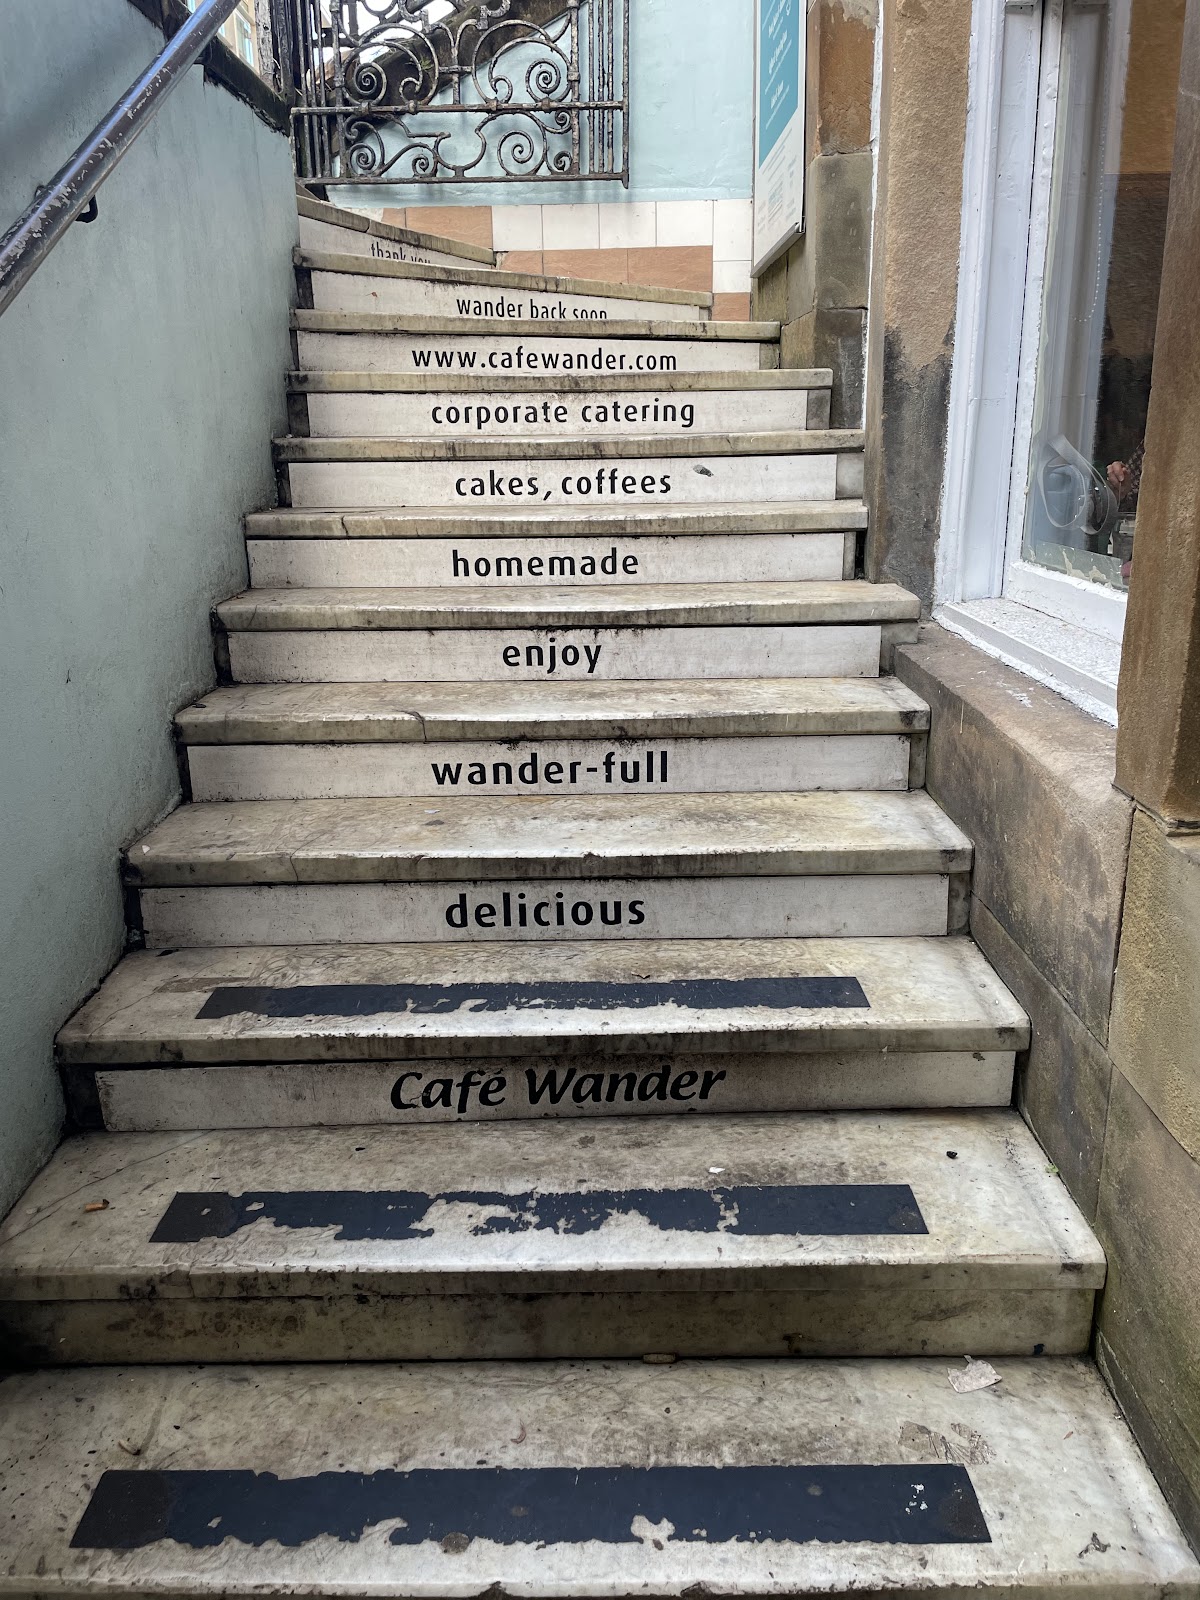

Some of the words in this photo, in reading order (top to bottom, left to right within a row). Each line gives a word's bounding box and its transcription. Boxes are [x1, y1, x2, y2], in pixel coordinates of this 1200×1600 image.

[456, 295, 523, 318] wander
[530, 299, 567, 319] back
[411, 345, 677, 371] www.cafewander.com
[431, 401, 568, 429] corporate
[581, 398, 694, 428] catering
[455, 469, 552, 501] cakes,
[561, 468, 671, 494] coffees
[453, 547, 639, 576] homemade
[502, 638, 602, 674] enjoy
[431, 751, 668, 784] wander-full
[446, 891, 645, 928] delicious
[390, 1069, 507, 1113] Café
[524, 1065, 727, 1104] Wander
